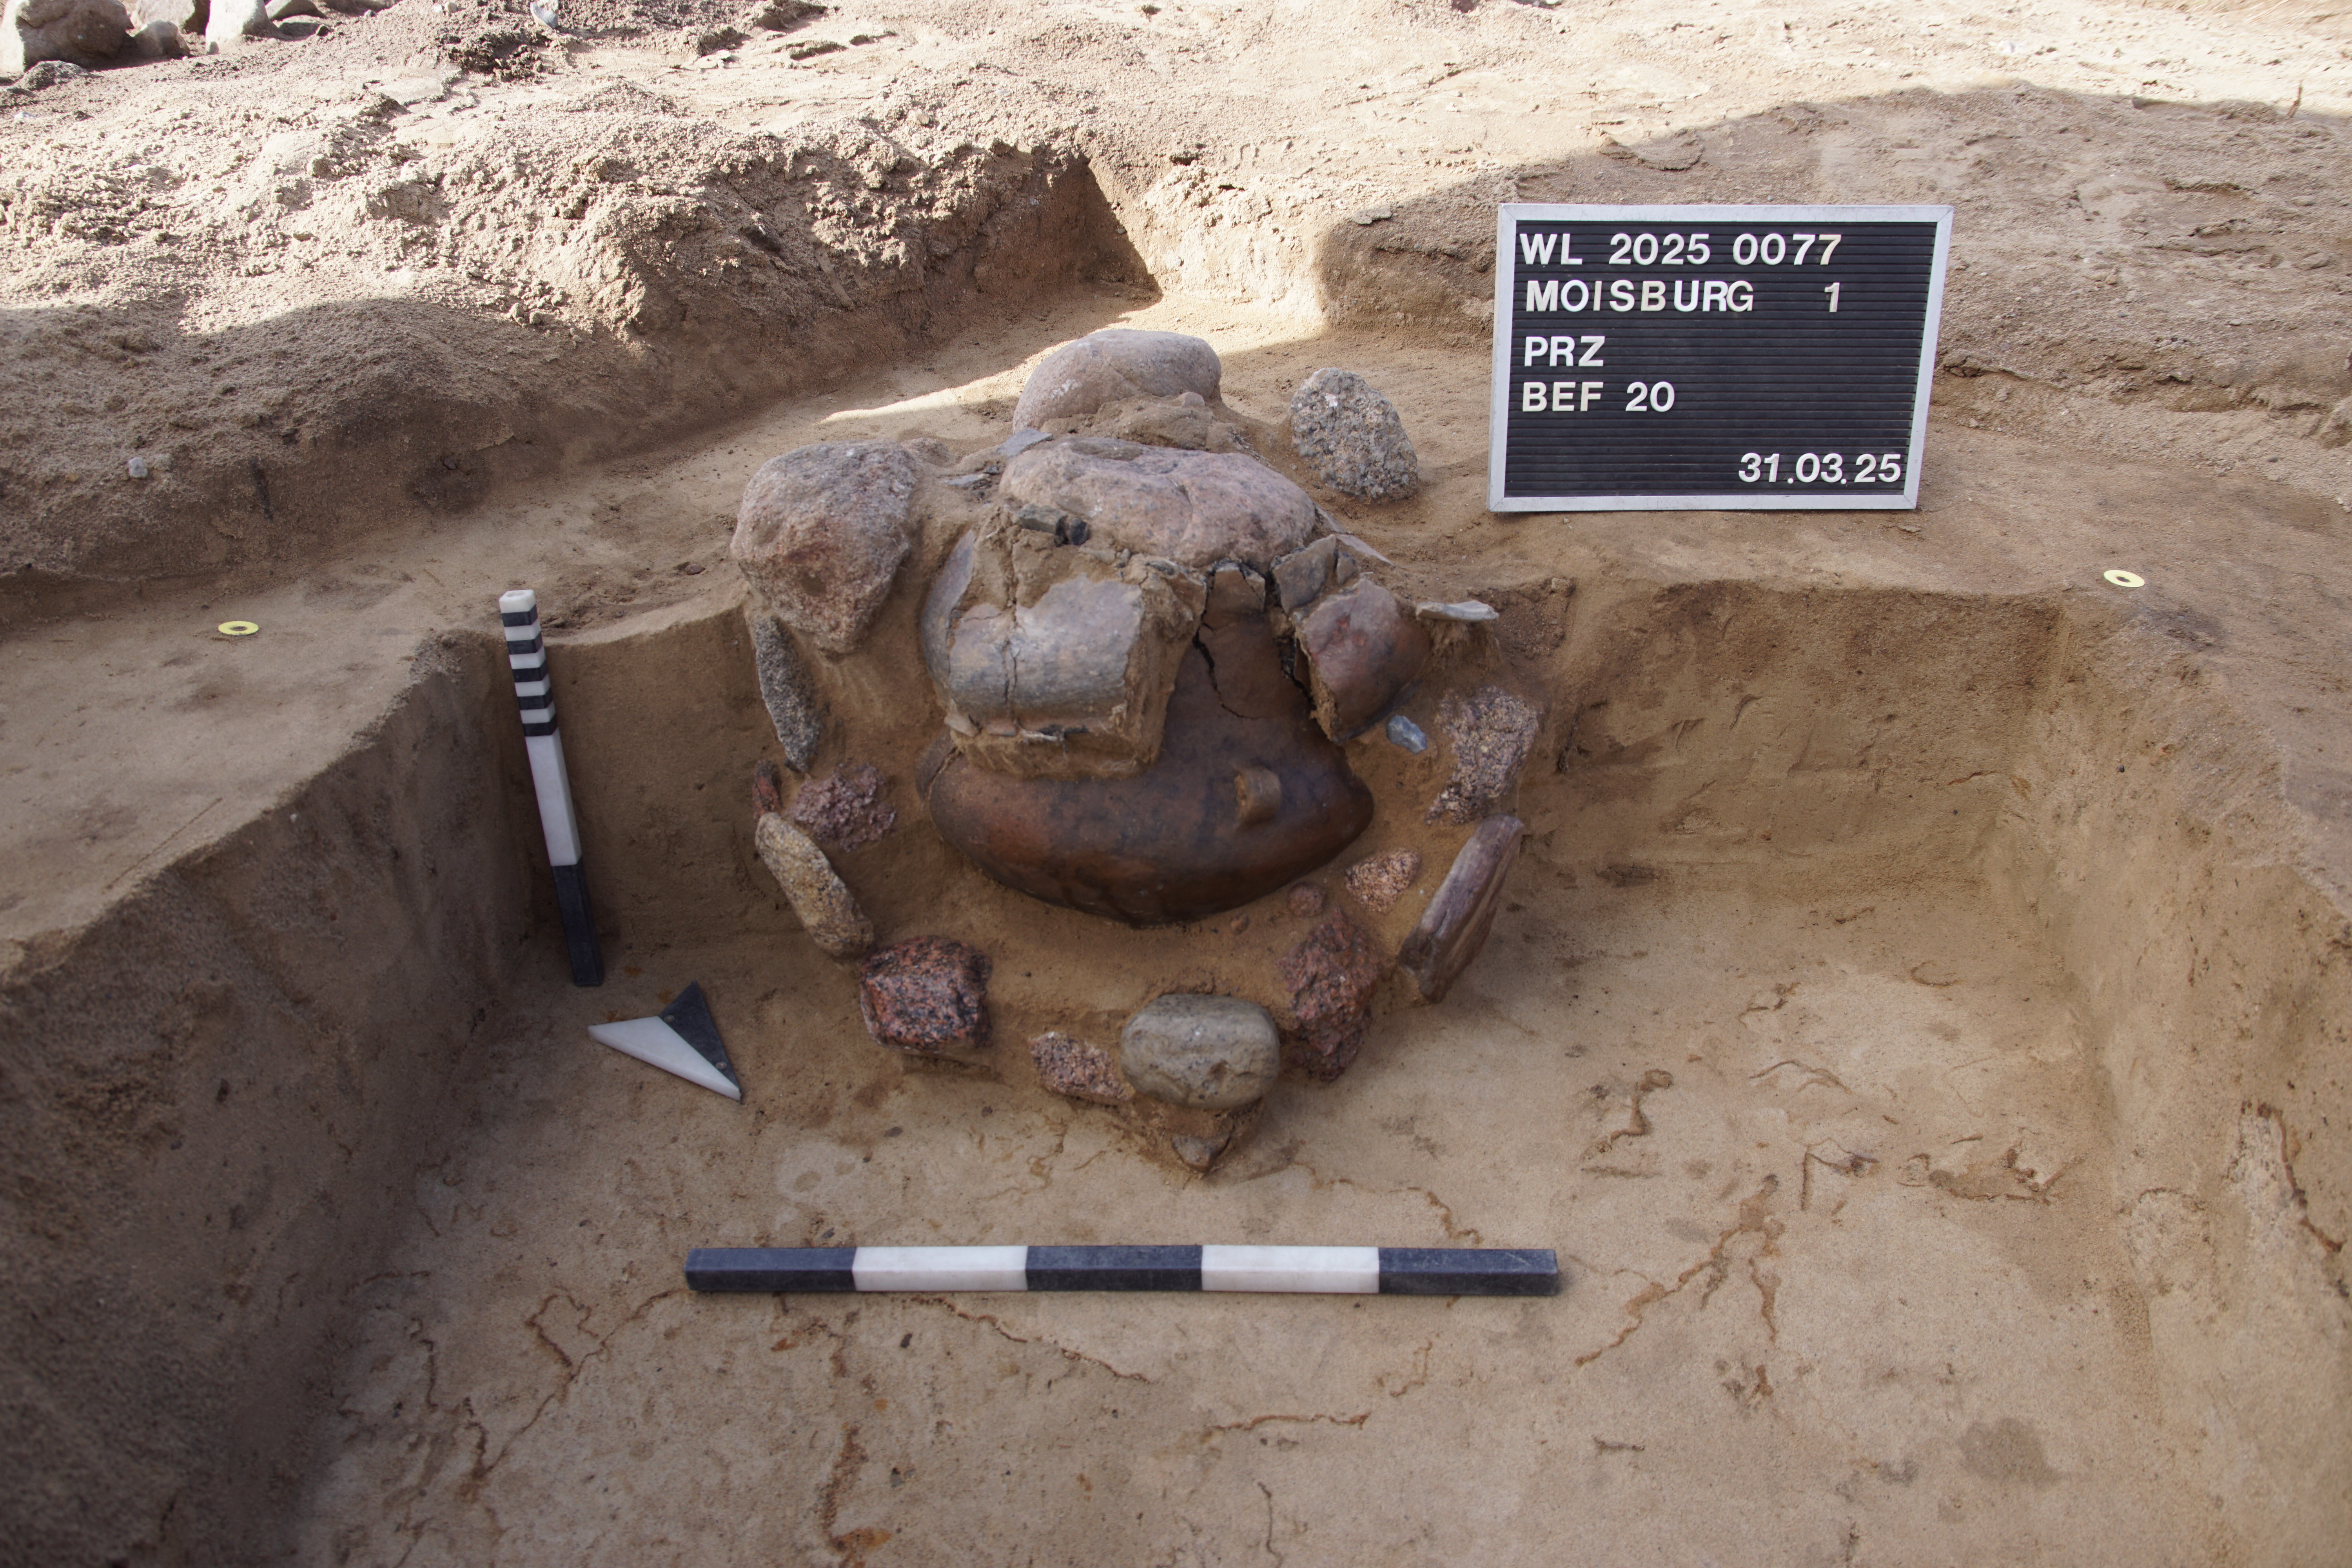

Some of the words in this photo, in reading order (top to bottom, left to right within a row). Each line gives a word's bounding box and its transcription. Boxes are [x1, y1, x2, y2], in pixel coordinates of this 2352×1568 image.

[1520, 233, 1583, 265] WL
[1609, 233, 1710, 265] 2025
[1733, 233, 1841, 265] 0077
[1526, 279, 1753, 312] MOISBURG
[1825, 282, 1840, 312] 1
[1524, 336, 1605, 367] PRZ
[1523, 382, 1603, 412] BEF
[1626, 381, 1675, 412] 20
[1739, 452, 1901, 484] 31.03.25
